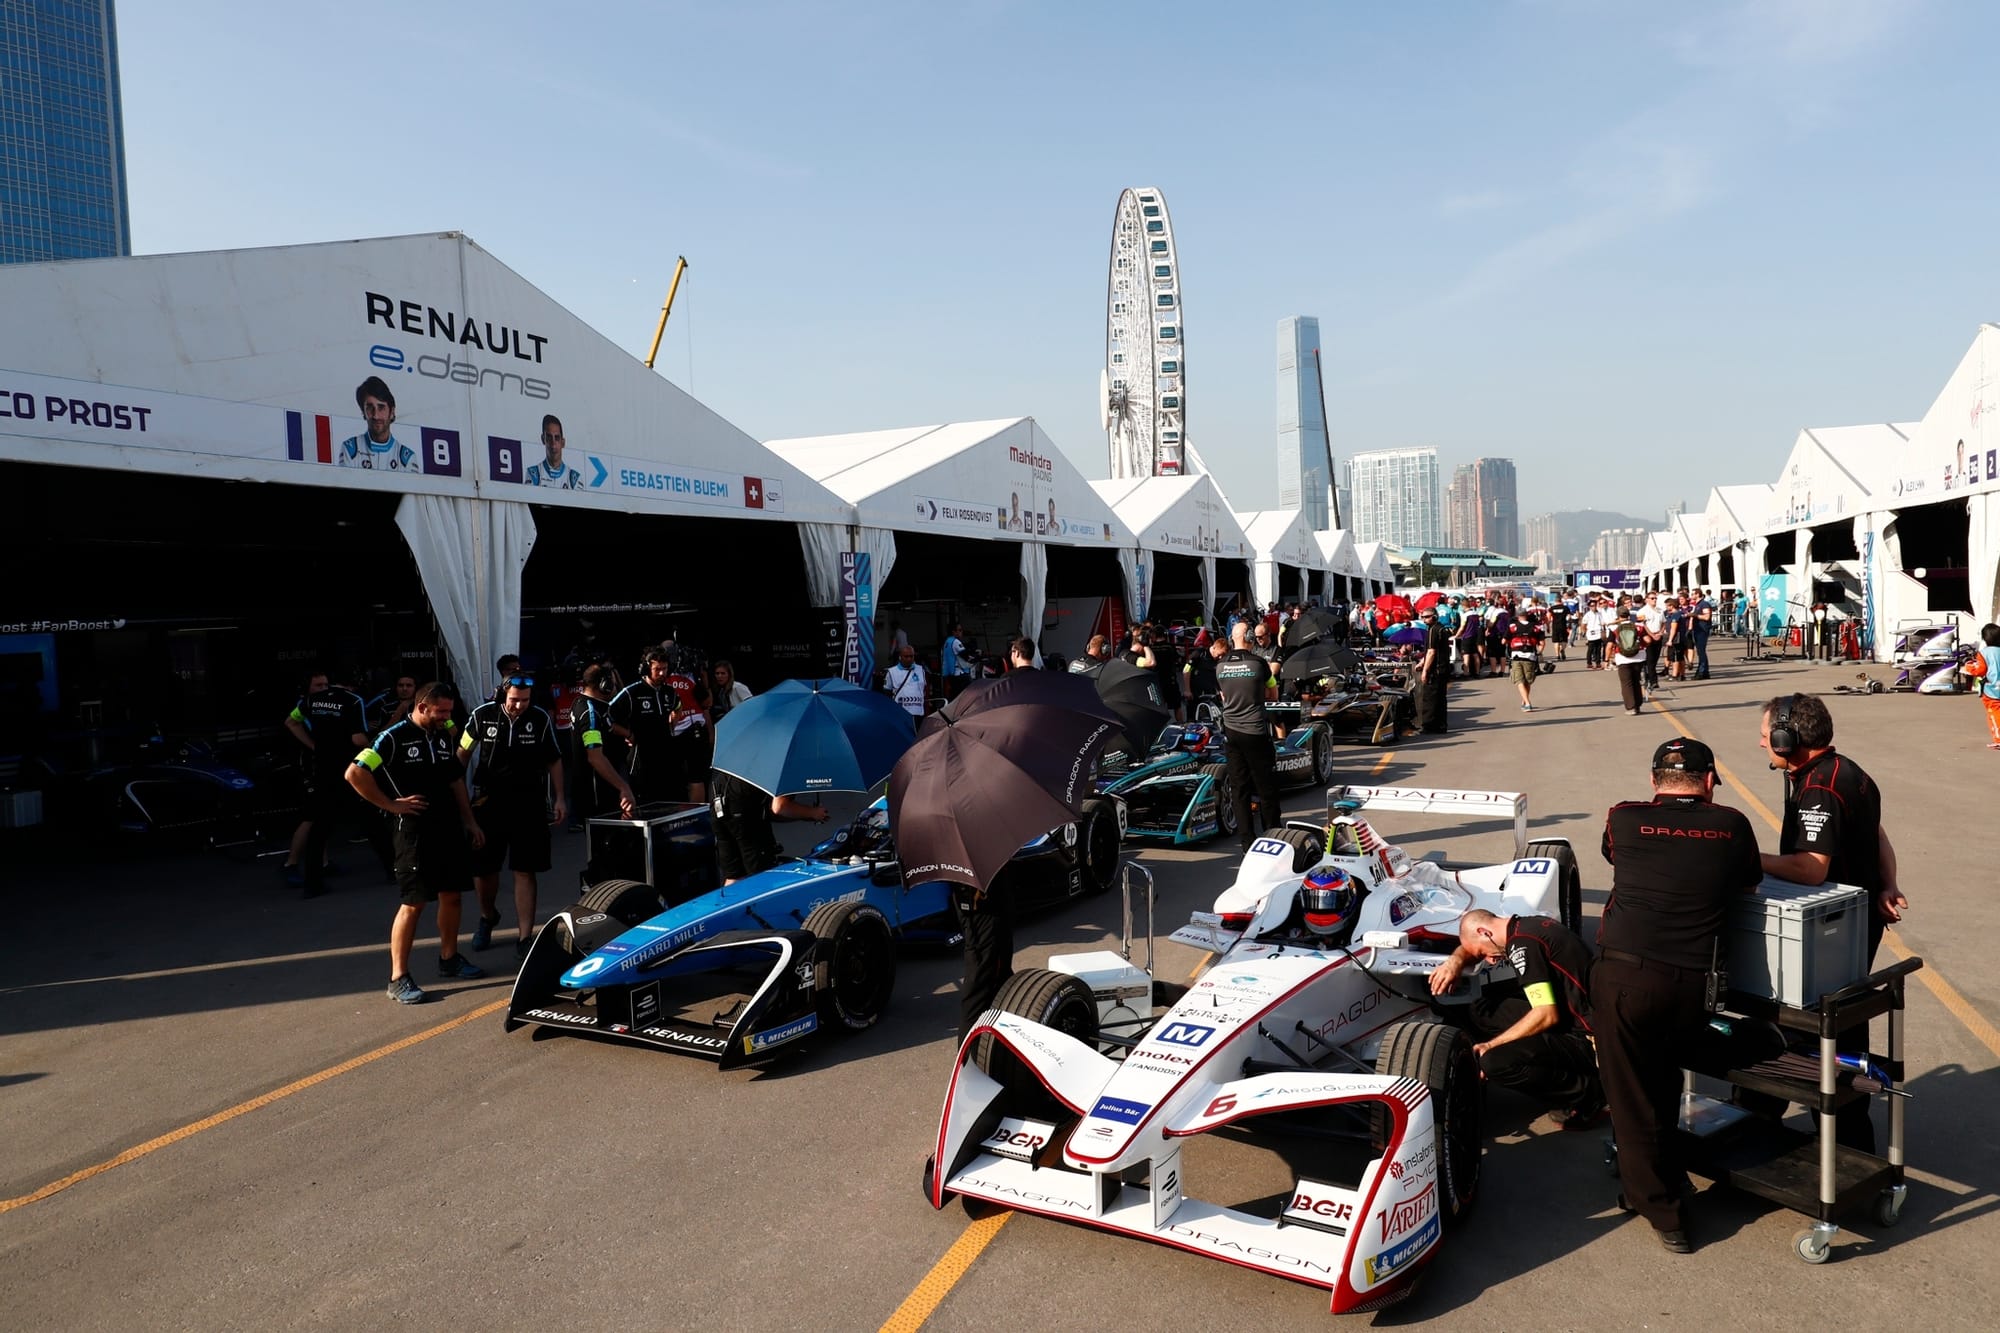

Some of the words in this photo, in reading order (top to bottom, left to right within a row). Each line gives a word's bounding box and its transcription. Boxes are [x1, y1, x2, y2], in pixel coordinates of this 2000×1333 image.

[365, 291, 548, 363] RENAULT
[369, 345, 551, 400] e.dams
[45, 396, 152, 432] PROST
[433, 439, 450, 466] 8
[499, 448, 513, 474] 9
[1009, 446, 1052, 470] Mahindra
[1988, 456, 1994, 474] 2
[620, 469, 690, 493] SEBASTIEN
[694, 480, 729, 497] BUEMI
[942, 507, 958, 519] FELIX
[959, 509, 992, 522] ROSENQVIST
[31, 619, 110, 632] #FanBoost
[1065, 756, 1082, 804] DRAGON
[1079, 722, 1109, 756] RACING
[1167, 761, 1199, 776] JAGUAR
[1273, 754, 1312, 772] anasonic
[1346, 786, 1515, 803] DRAGON
[1640, 825, 1734, 839] DRAGON
[1257, 841, 1282, 854] M
[905, 864, 939, 879] DRAGON
[941, 863, 974, 877] RACING
[1516, 861, 1547, 873] M
[620, 939, 672, 972] RICHARD
[674, 922, 706, 944] MILLE
[1174, 931, 1229, 946] PNSKE
[1306, 983, 1393, 1053] DRAGON
[643, 1026, 728, 1048] RENAULT
[768, 1020, 812, 1042] MICHELIN
[1162, 1025, 1209, 1044] M
[1133, 1050, 1194, 1066] molex
[1131, 1063, 1184, 1077] FANBOOST
[1100, 1103, 1122, 1113] Julius
[1124, 1108, 1140, 1116] Bär
[1203, 1093, 1237, 1118] 6
[993, 1128, 1044, 1149] BGR
[1403, 1142, 1435, 1172] instafore
[1402, 1159, 1437, 1191] PMC
[959, 1176, 1092, 1211] DRAGON
[1291, 1194, 1353, 1221] BGR
[1376, 1179, 1438, 1245] VARIETY
[1169, 1225, 1332, 1274] DRAGON
[1393, 1223, 1437, 1265] MICHELIN
